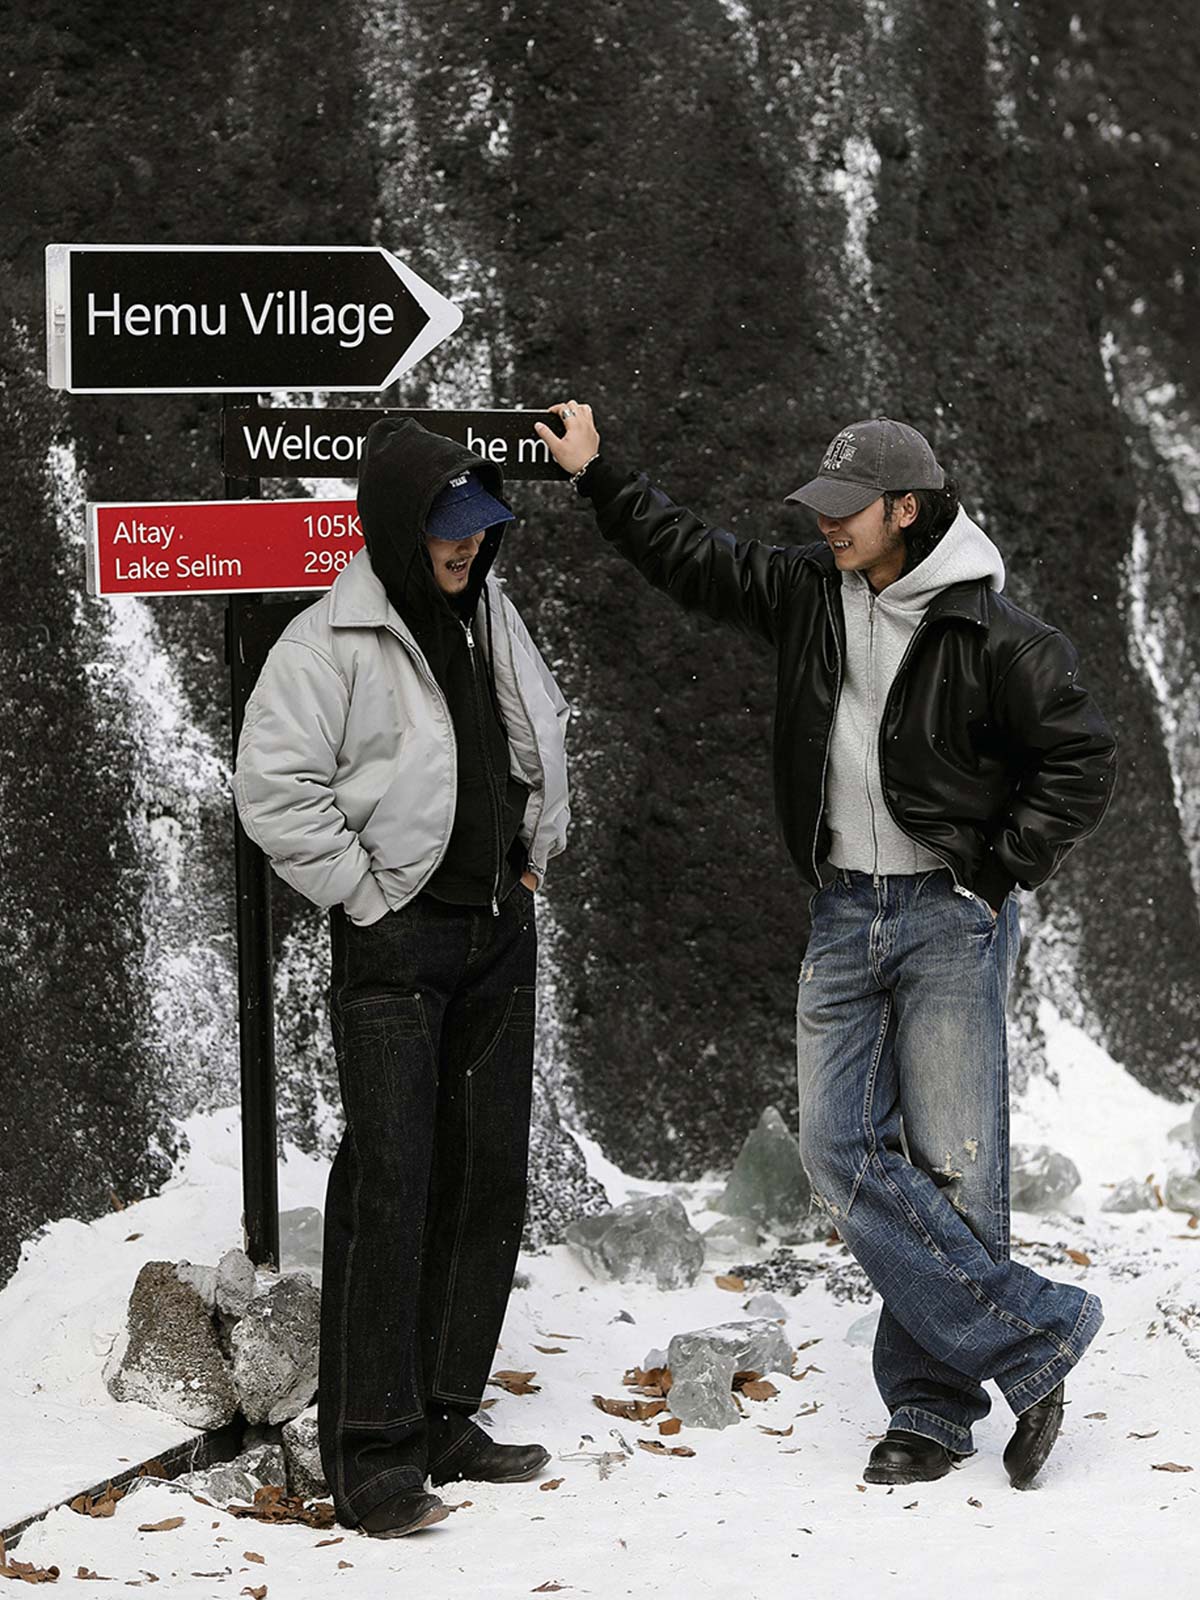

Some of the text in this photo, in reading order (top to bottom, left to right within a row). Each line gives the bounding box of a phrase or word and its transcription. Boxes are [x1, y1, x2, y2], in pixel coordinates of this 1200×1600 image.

[88, 290, 394, 348] Hemu Village
[113, 514, 363, 550] Altay 105K
[115, 550, 354, 580] Lake Selim 298
